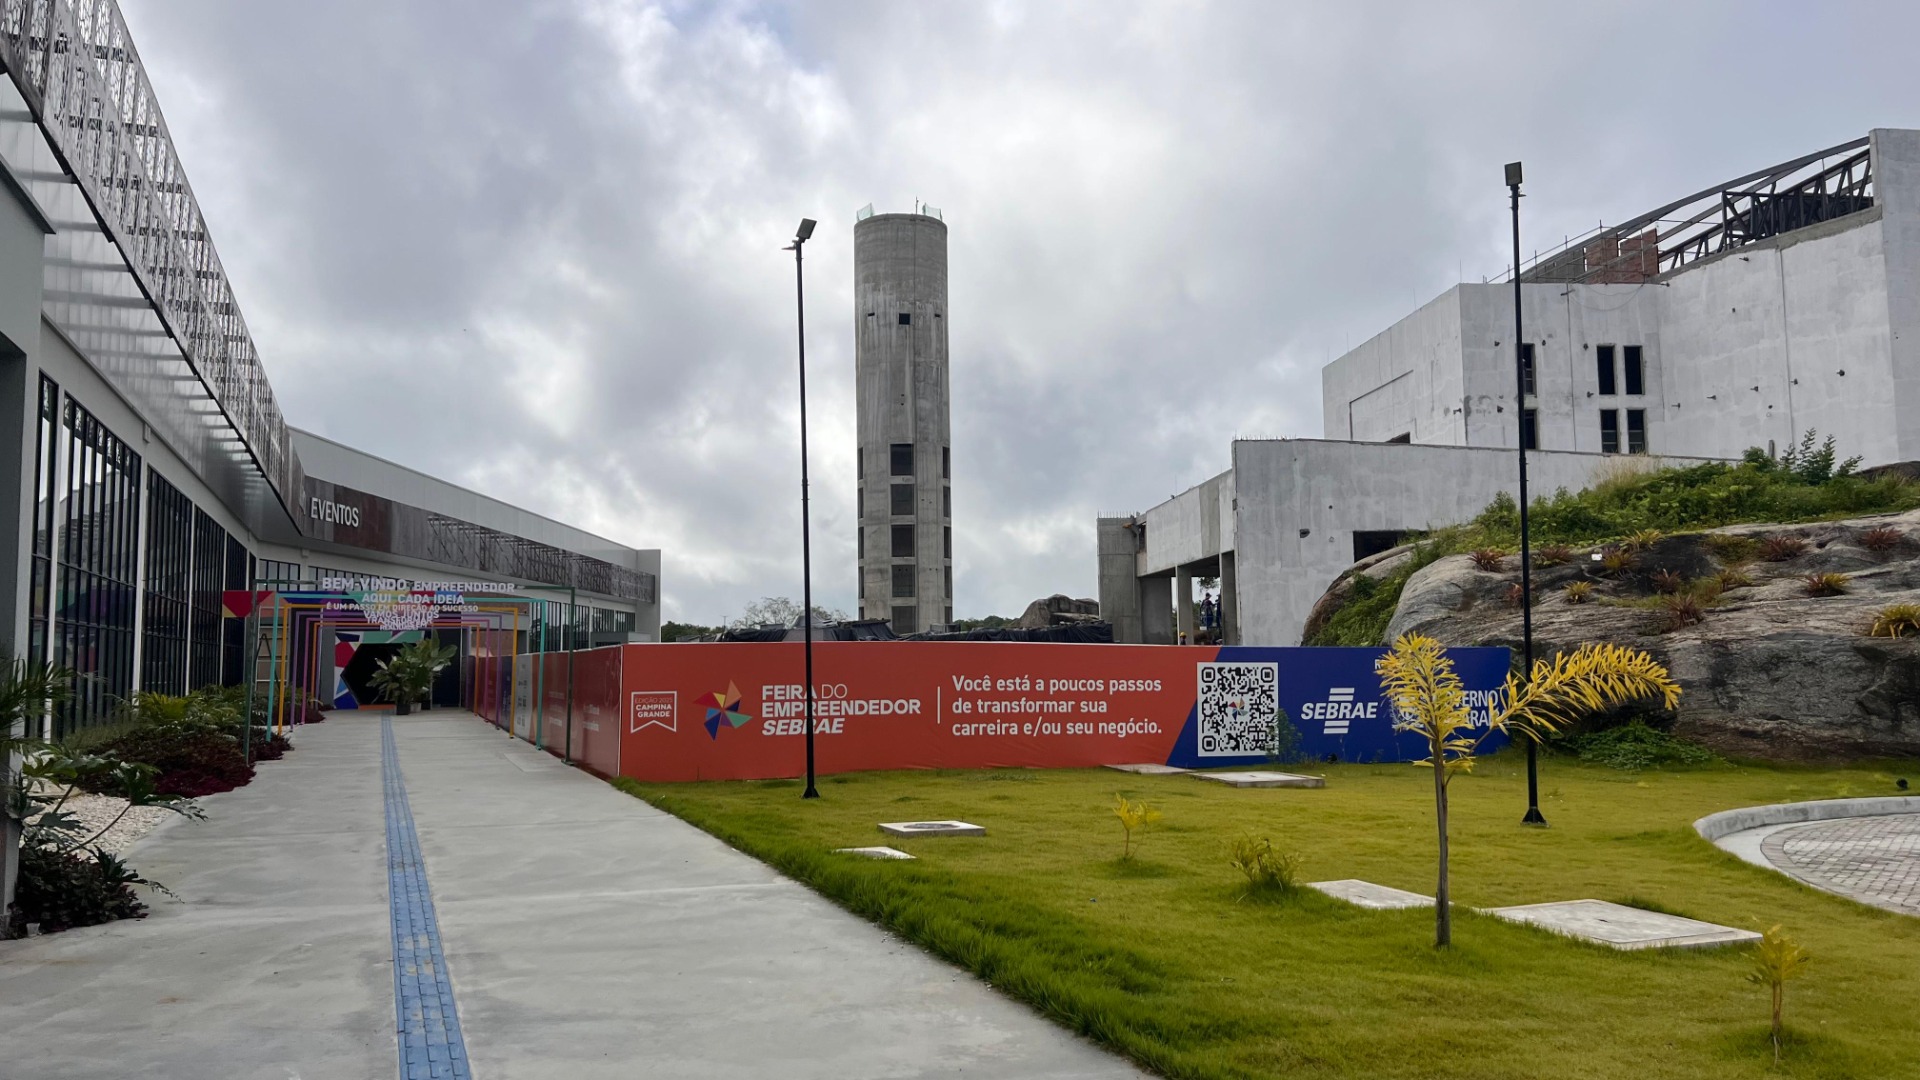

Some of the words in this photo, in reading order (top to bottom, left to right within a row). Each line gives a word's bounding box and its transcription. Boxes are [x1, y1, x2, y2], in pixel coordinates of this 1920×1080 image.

[311, 497, 359, 528] EVENTOS
[322, 577, 407, 590] BEM-VINDO
[413, 580, 515, 592] EMPREENDEDOR
[361, 593, 392, 603] AQUI
[398, 594, 429, 604] CADA
[433, 594, 465, 604] IDEIA
[350, 603, 375, 611] PASSO
[429, 604, 440, 612] AO
[442, 604, 479, 612] SUCESSO
[364, 610, 398, 619] VAMOS
[403, 609, 439, 619] JUNTOS
[762, 685, 817, 700] FEIRA
[821, 684, 848, 699] DO
[952, 674, 992, 691] Você
[996, 675, 1031, 691] está
[1035, 678, 1045, 691] a
[1049, 678, 1104, 695] poucos
[1109, 678, 1162, 695] passos
[762, 699, 921, 717] EMPREENDEDOR
[952, 697, 972, 713] de
[977, 697, 1075, 713] transformar
[1080, 700, 1107, 713] sua
[1300, 702, 1379, 720] SEBRAE
[952, 719, 1018, 736] carreira
[1023, 716, 1061, 737] e/ou
[1066, 722, 1093, 734] seu
[1098, 718, 1162, 738] negócio.
